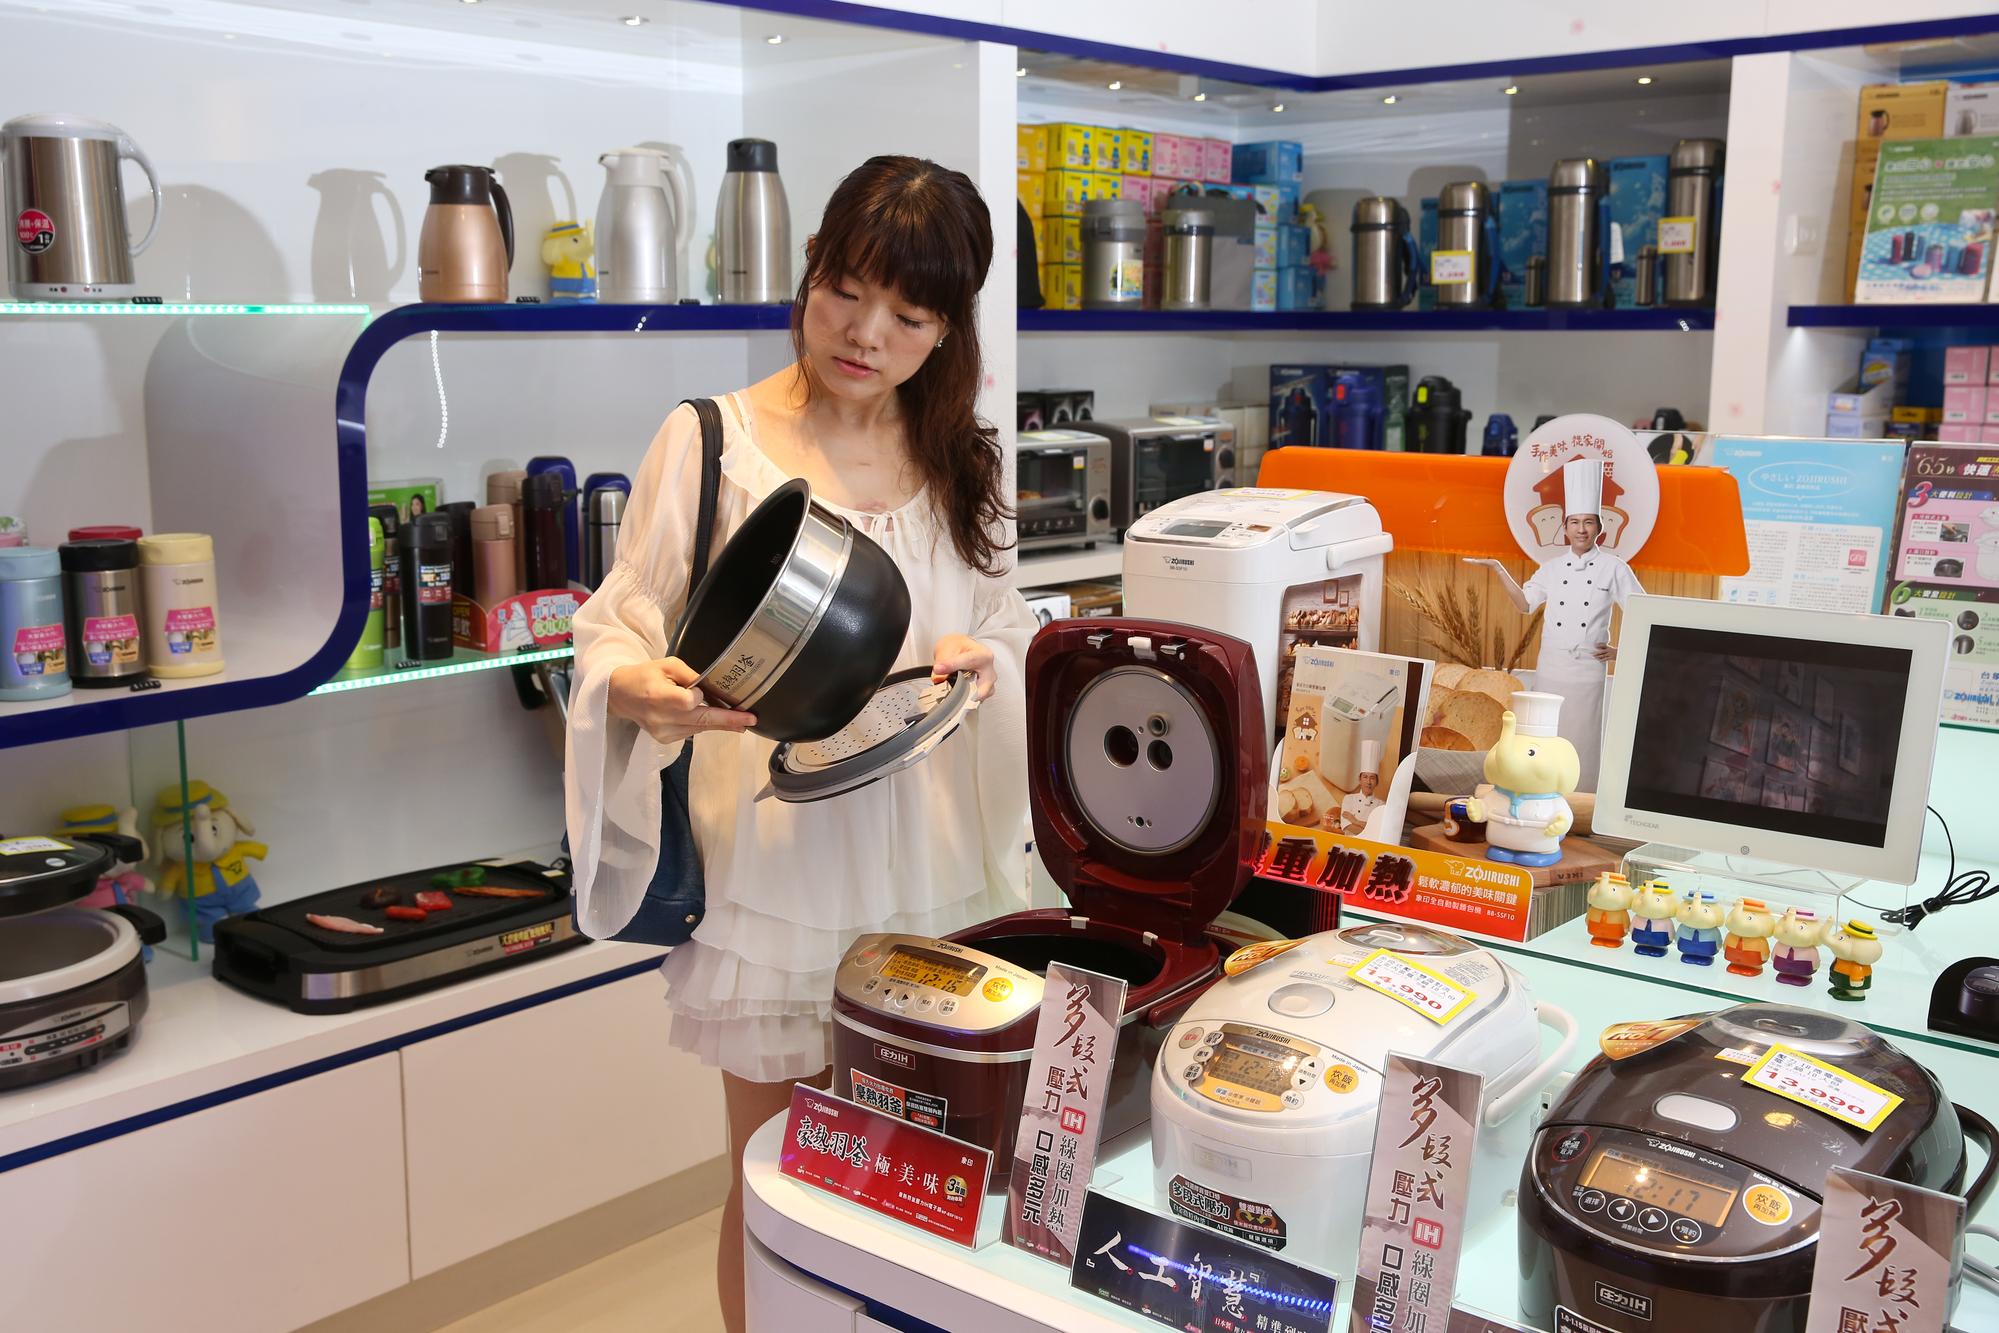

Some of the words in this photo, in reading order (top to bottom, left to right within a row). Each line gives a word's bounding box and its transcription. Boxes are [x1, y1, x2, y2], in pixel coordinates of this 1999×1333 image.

[1465, 865, 1520, 887] ZOJIRUSHI
[1418, 875, 1518, 906] 鬆軟濃郁的美味關鍵
[1256, 1030, 1290, 1045] ZOJIRUSHI
[1331, 1053, 1345, 1062] Made
[1331, 1069, 1353, 1084] 炊飯
[1042, 1065, 1067, 1114] 壓力
[813, 1101, 839, 1118] ZOJIRUSHI
[1063, 1109, 1084, 1131] IH
[797, 1115, 871, 1169] 豪熱羽釜
[1658, 1142, 1696, 1159] ZOJIRUSHI
[961, 1156, 974, 1167] 象印
[1022, 1129, 1054, 1225] 口感多元
[1046, 1134, 1078, 1233] 線圈加熱
[1753, 1172, 1771, 1184] Made
[1779, 1183, 1801, 1199] Japan
[1172, 1181, 1230, 1220] 多段式壓力
[1387, 1169, 1416, 1225] 壓力
[1414, 1220, 1441, 1246] IH
[1754, 1191, 1782, 1212] 炊飯
[1680, 1224, 1698, 1238] 預約
